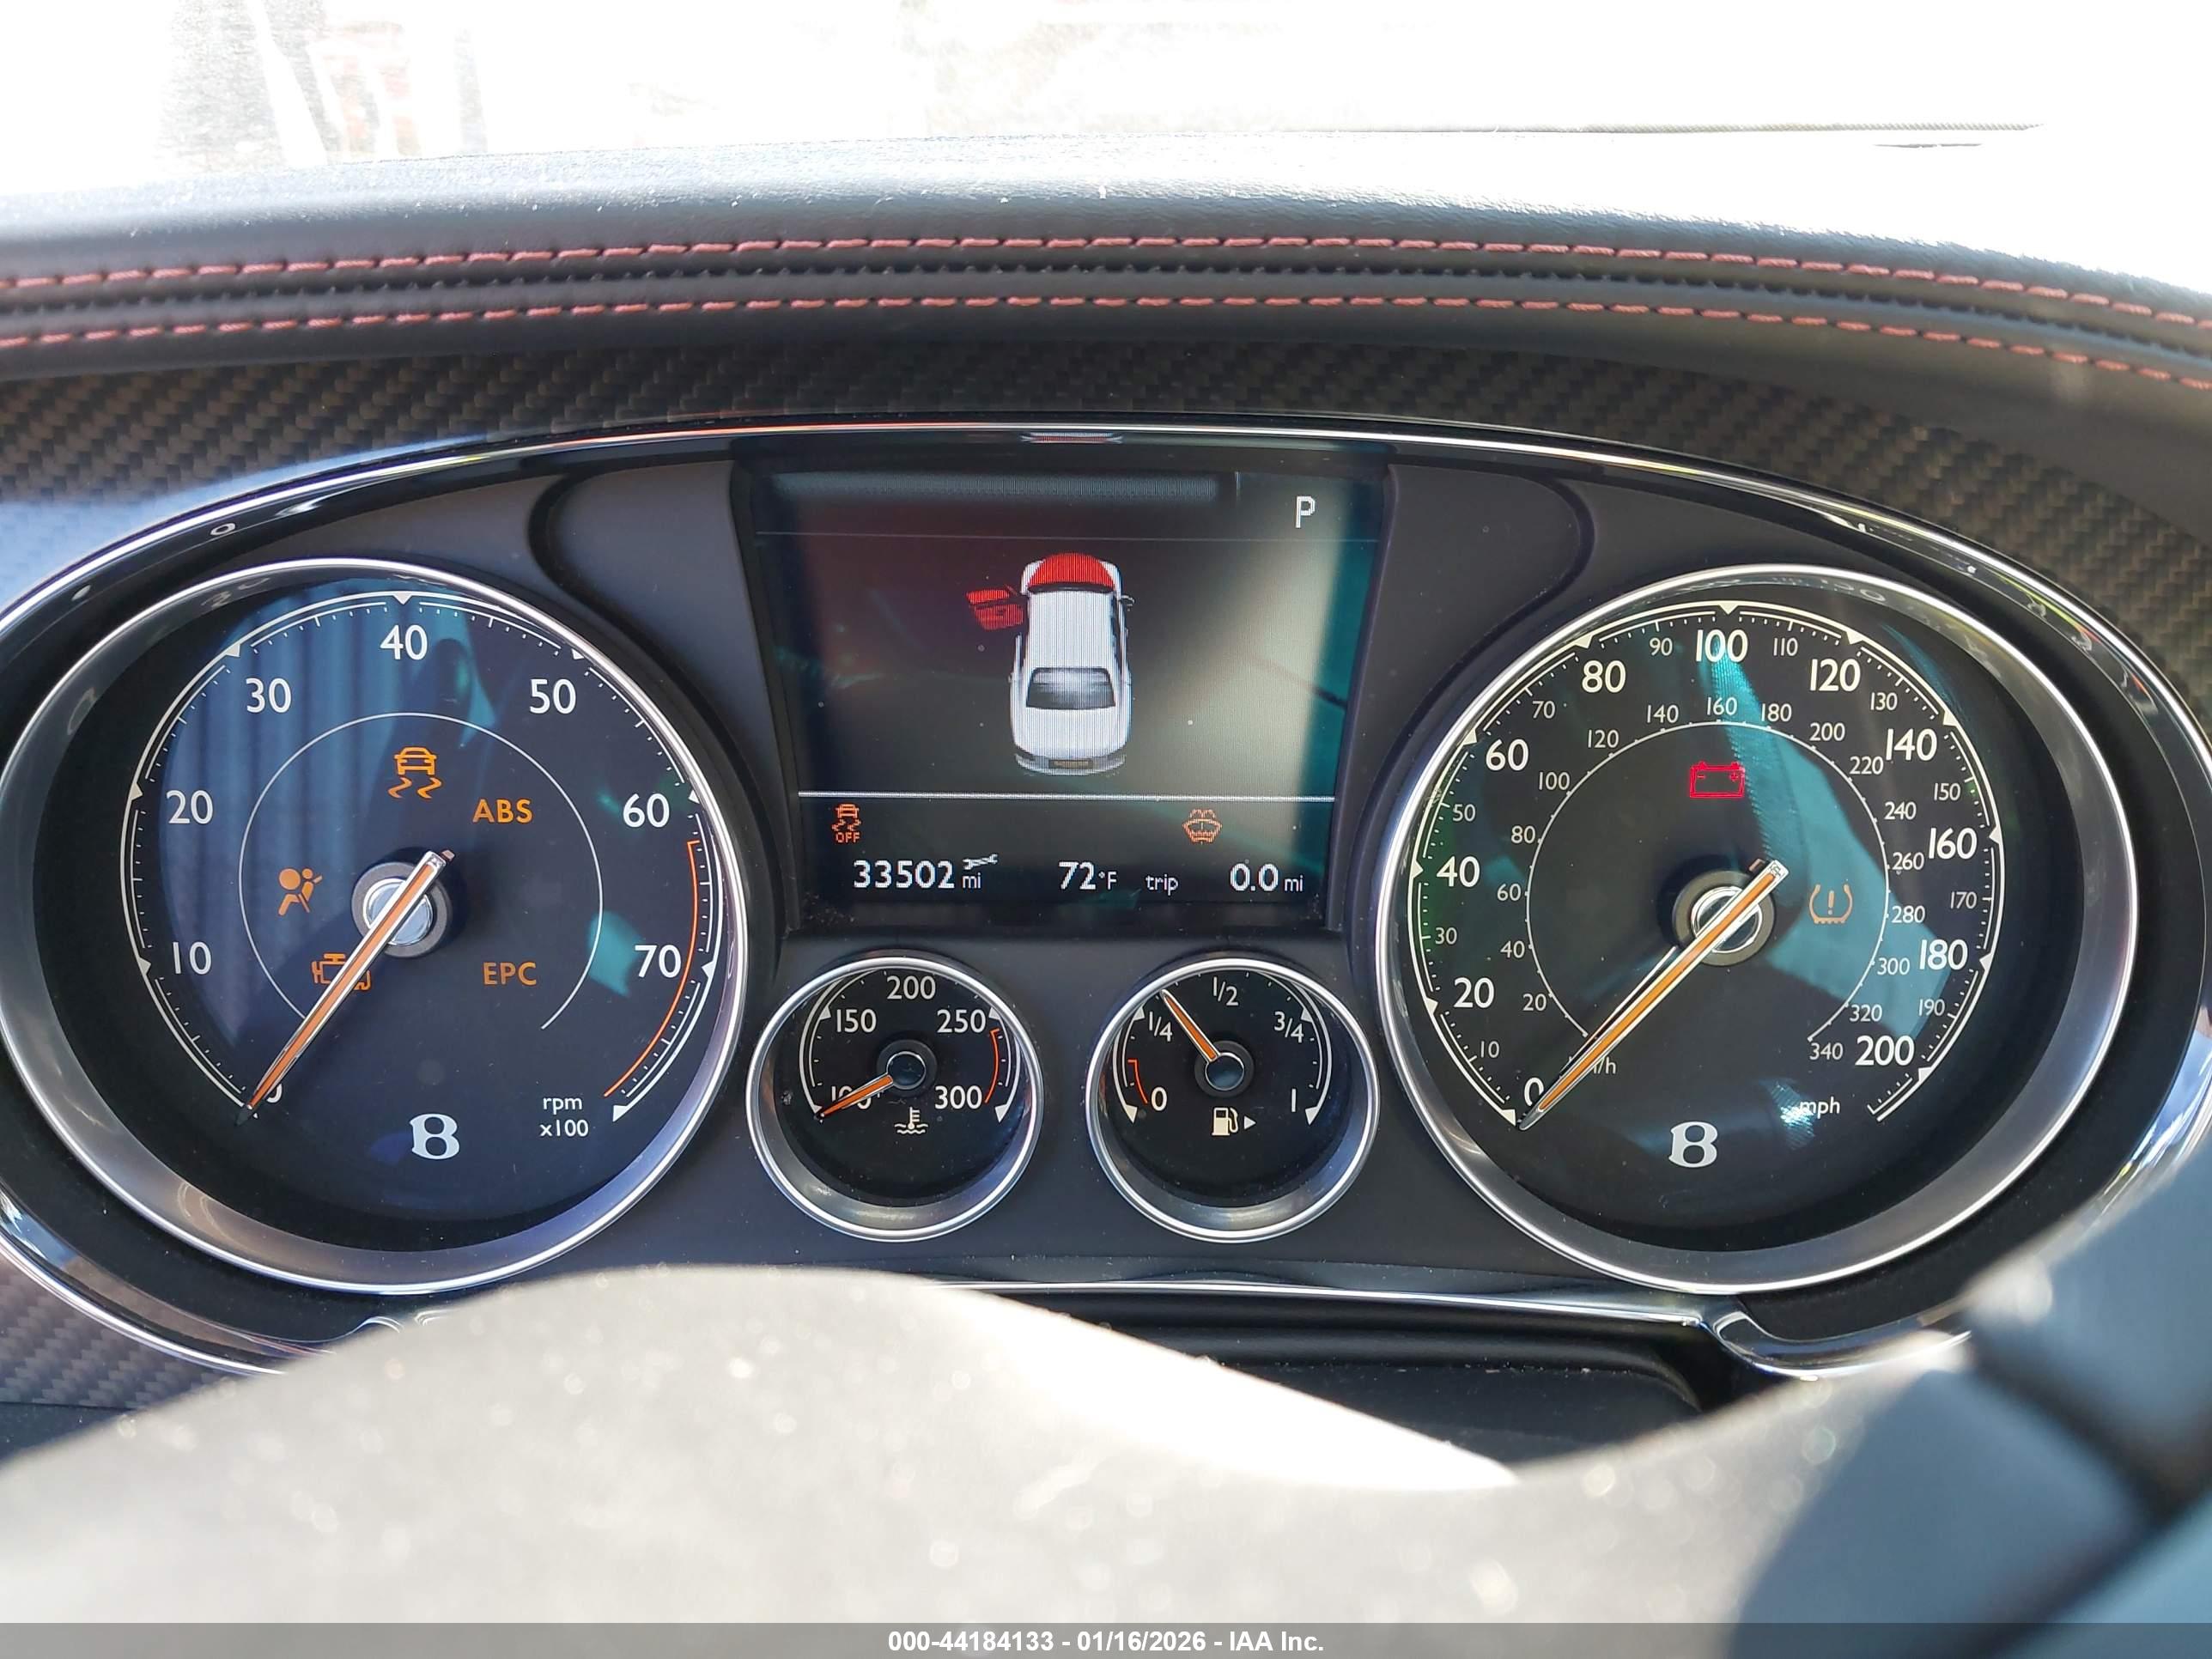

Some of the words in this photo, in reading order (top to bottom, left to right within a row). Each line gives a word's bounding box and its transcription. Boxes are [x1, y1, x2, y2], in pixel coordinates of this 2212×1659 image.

[1296, 496, 1315, 528] P
[380, 625, 427, 659] 40
[1650, 638, 1672, 655] 90
[1695, 629, 1748, 662] 100
[1774, 638, 1797, 656] 110
[1583, 660, 1626, 692] 80
[1810, 659, 1860, 691] 120
[246, 678, 291, 713] 30
[530, 679, 575, 714] 50
[1706, 697, 1737, 715] 160
[1871, 692, 1897, 710] 130
[1533, 701, 1555, 718] 70
[1648, 705, 1679, 723] 140
[1761, 703, 1791, 722] 180
[1587, 730, 1620, 748] 120
[1810, 723, 1844, 740] 200
[1486, 739, 1528, 770] 60
[1885, 729, 1937, 761] 140
[1850, 757, 1884, 775] 220
[1538, 772, 1571, 791] 100
[1935, 783, 1960, 800] 150
[167, 790, 213, 823] 20
[473, 799, 532, 823] ABS
[623, 793, 669, 827] 60
[1452, 805, 1476, 823] 50
[1885, 802, 1916, 819] 240
[835, 831, 860, 843] OFF
[1510, 825, 1536, 844] 80
[1929, 828, 1977, 859] 160
[1437, 856, 1480, 887] 40
[1892, 853, 1924, 872] 260
[854, 860, 954, 888] 33502
[963, 872, 981, 888] mi
[1146, 874, 1178, 896] trip
[1230, 863, 1279, 891] 0.0
[1285, 875, 1303, 891] mi
[1498, 884, 1521, 901] 60
[1951, 891, 1977, 908] 170
[1892, 905, 1926, 924] 280
[1436, 927, 1456, 944] 30
[173, 942, 211, 974] 10
[1501, 941, 1524, 957] 40
[1918, 939, 1968, 971] 180
[635, 944, 682, 978] 70
[1876, 957, 1911, 975] 300
[484, 963, 536, 985] EPC
[886, 975, 936, 1000] 200
[1213, 977, 1238, 1006] 1/2
[1454, 977, 1494, 1007] 20
[1522, 994, 1547, 1012] 20
[1849, 1005, 1883, 1023] 320
[1917, 999, 1945, 1017] 190
[837, 1009, 876, 1032] 150
[936, 1009, 987, 1034] 250
[1149, 1011, 1173, 1042] 1/4
[1273, 1011, 1304, 1043] 3/4
[1481, 1042, 1499, 1058] 10
[1808, 1042, 1844, 1060] 340
[1854, 1035, 1915, 1066] 200
[544, 1098, 582, 1115] rpm
[935, 1085, 981, 1109] 300
[1152, 1087, 1167, 1110] 0
[1800, 1097, 1841, 1120] mph
[540, 1120, 588, 1136] x100
